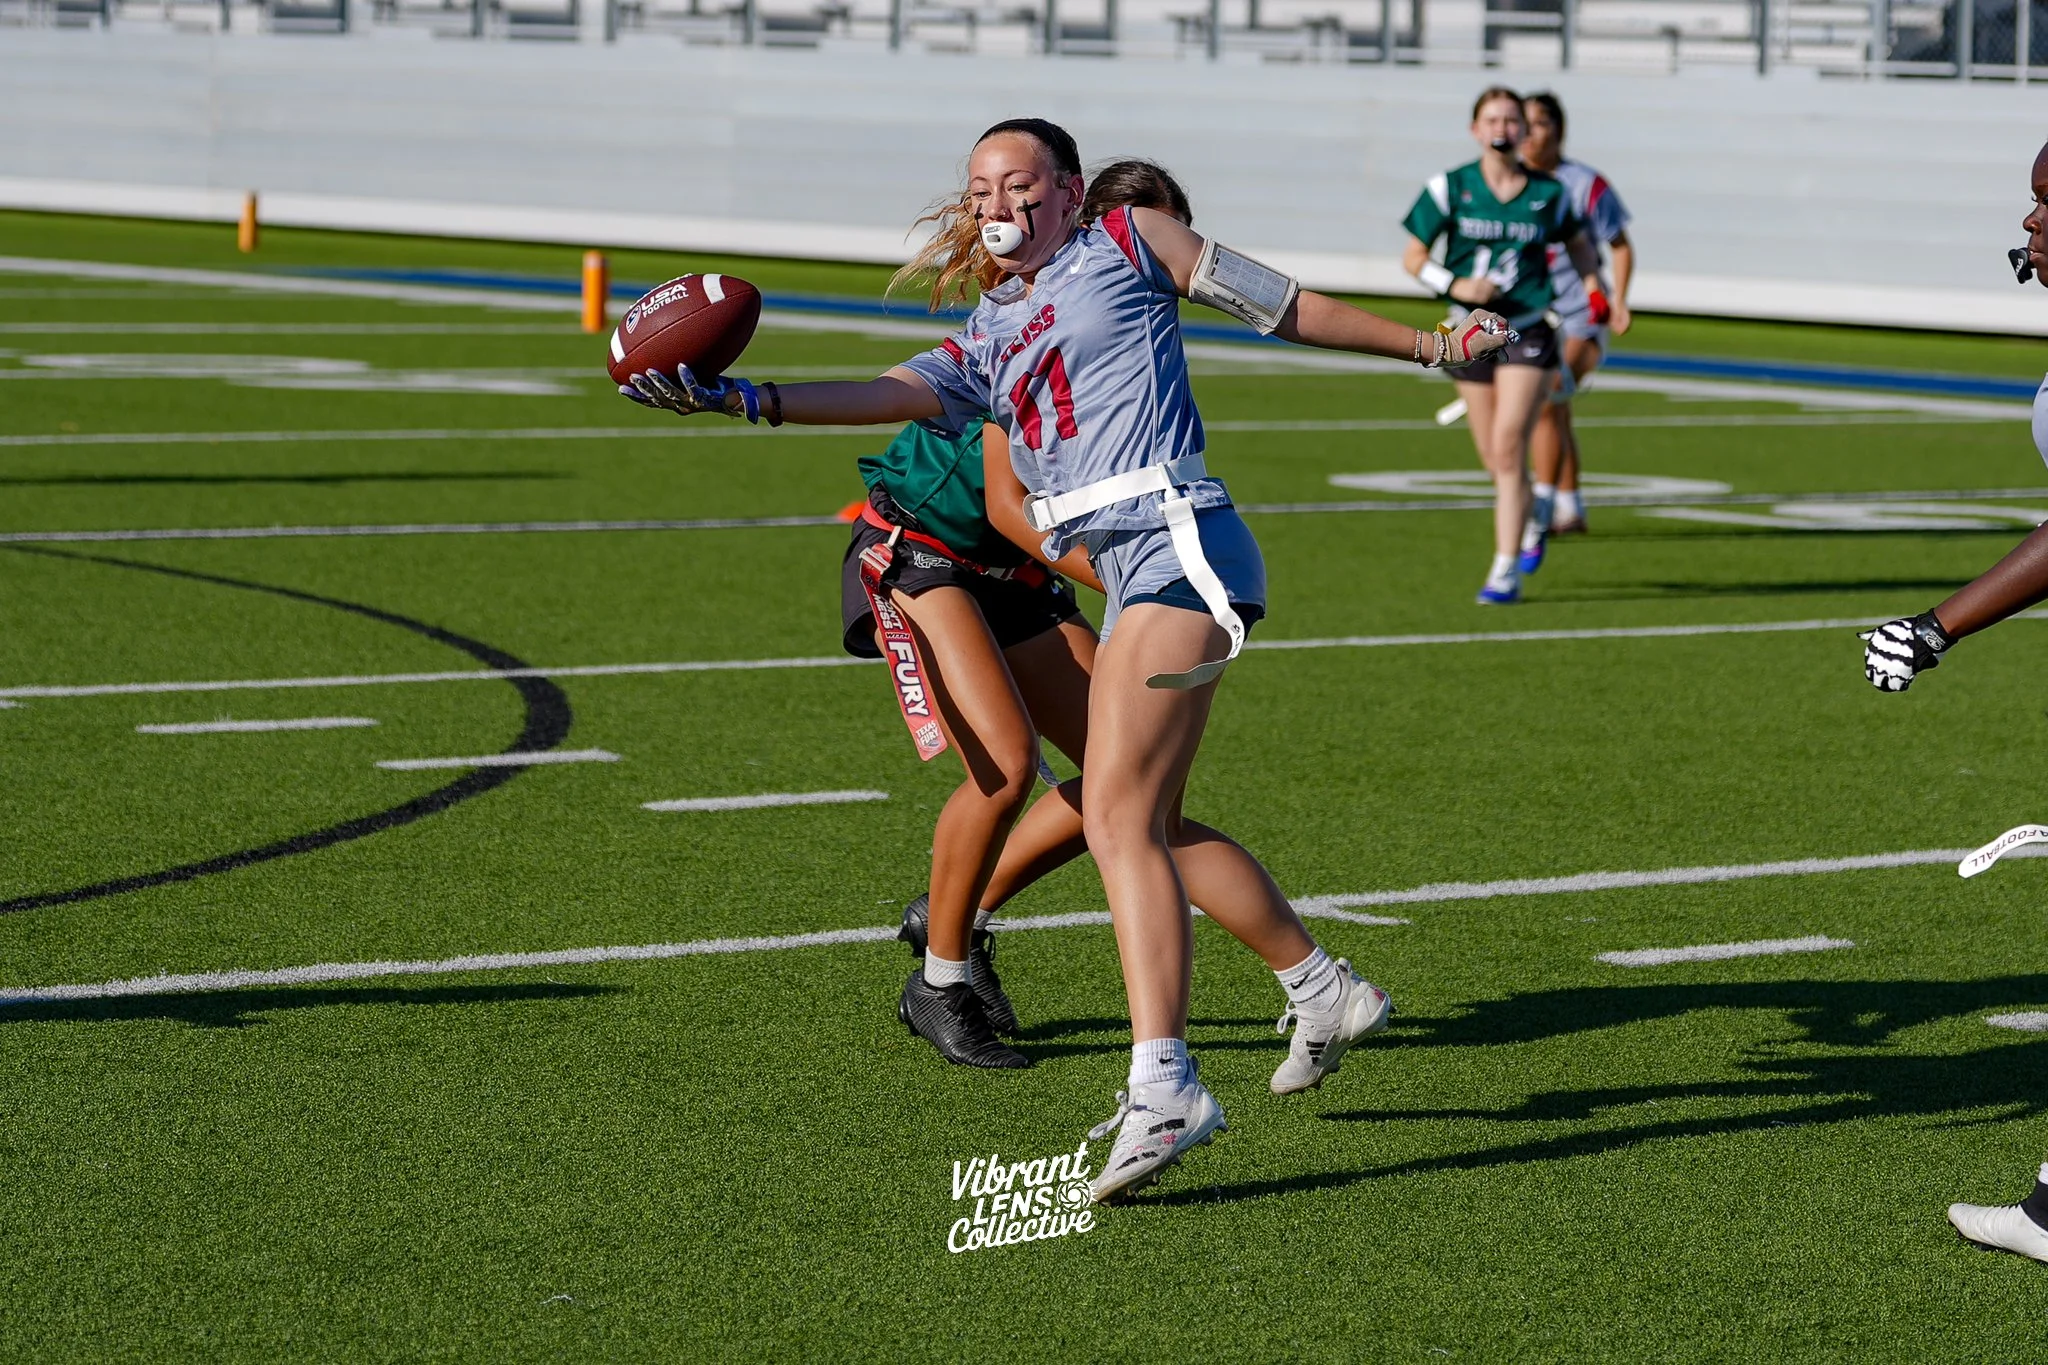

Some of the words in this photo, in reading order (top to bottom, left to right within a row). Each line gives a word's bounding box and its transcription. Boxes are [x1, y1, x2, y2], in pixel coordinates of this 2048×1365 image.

[641, 283, 687, 311] USA
[642, 291, 689, 318] FOOTBALL
[872, 593, 894, 629] MESS
[887, 641, 930, 717] FURY
[915, 720, 937, 738] TEXAS
[920, 727, 939, 746] FURY
[1970, 829, 2037, 867] FOOTBALL
